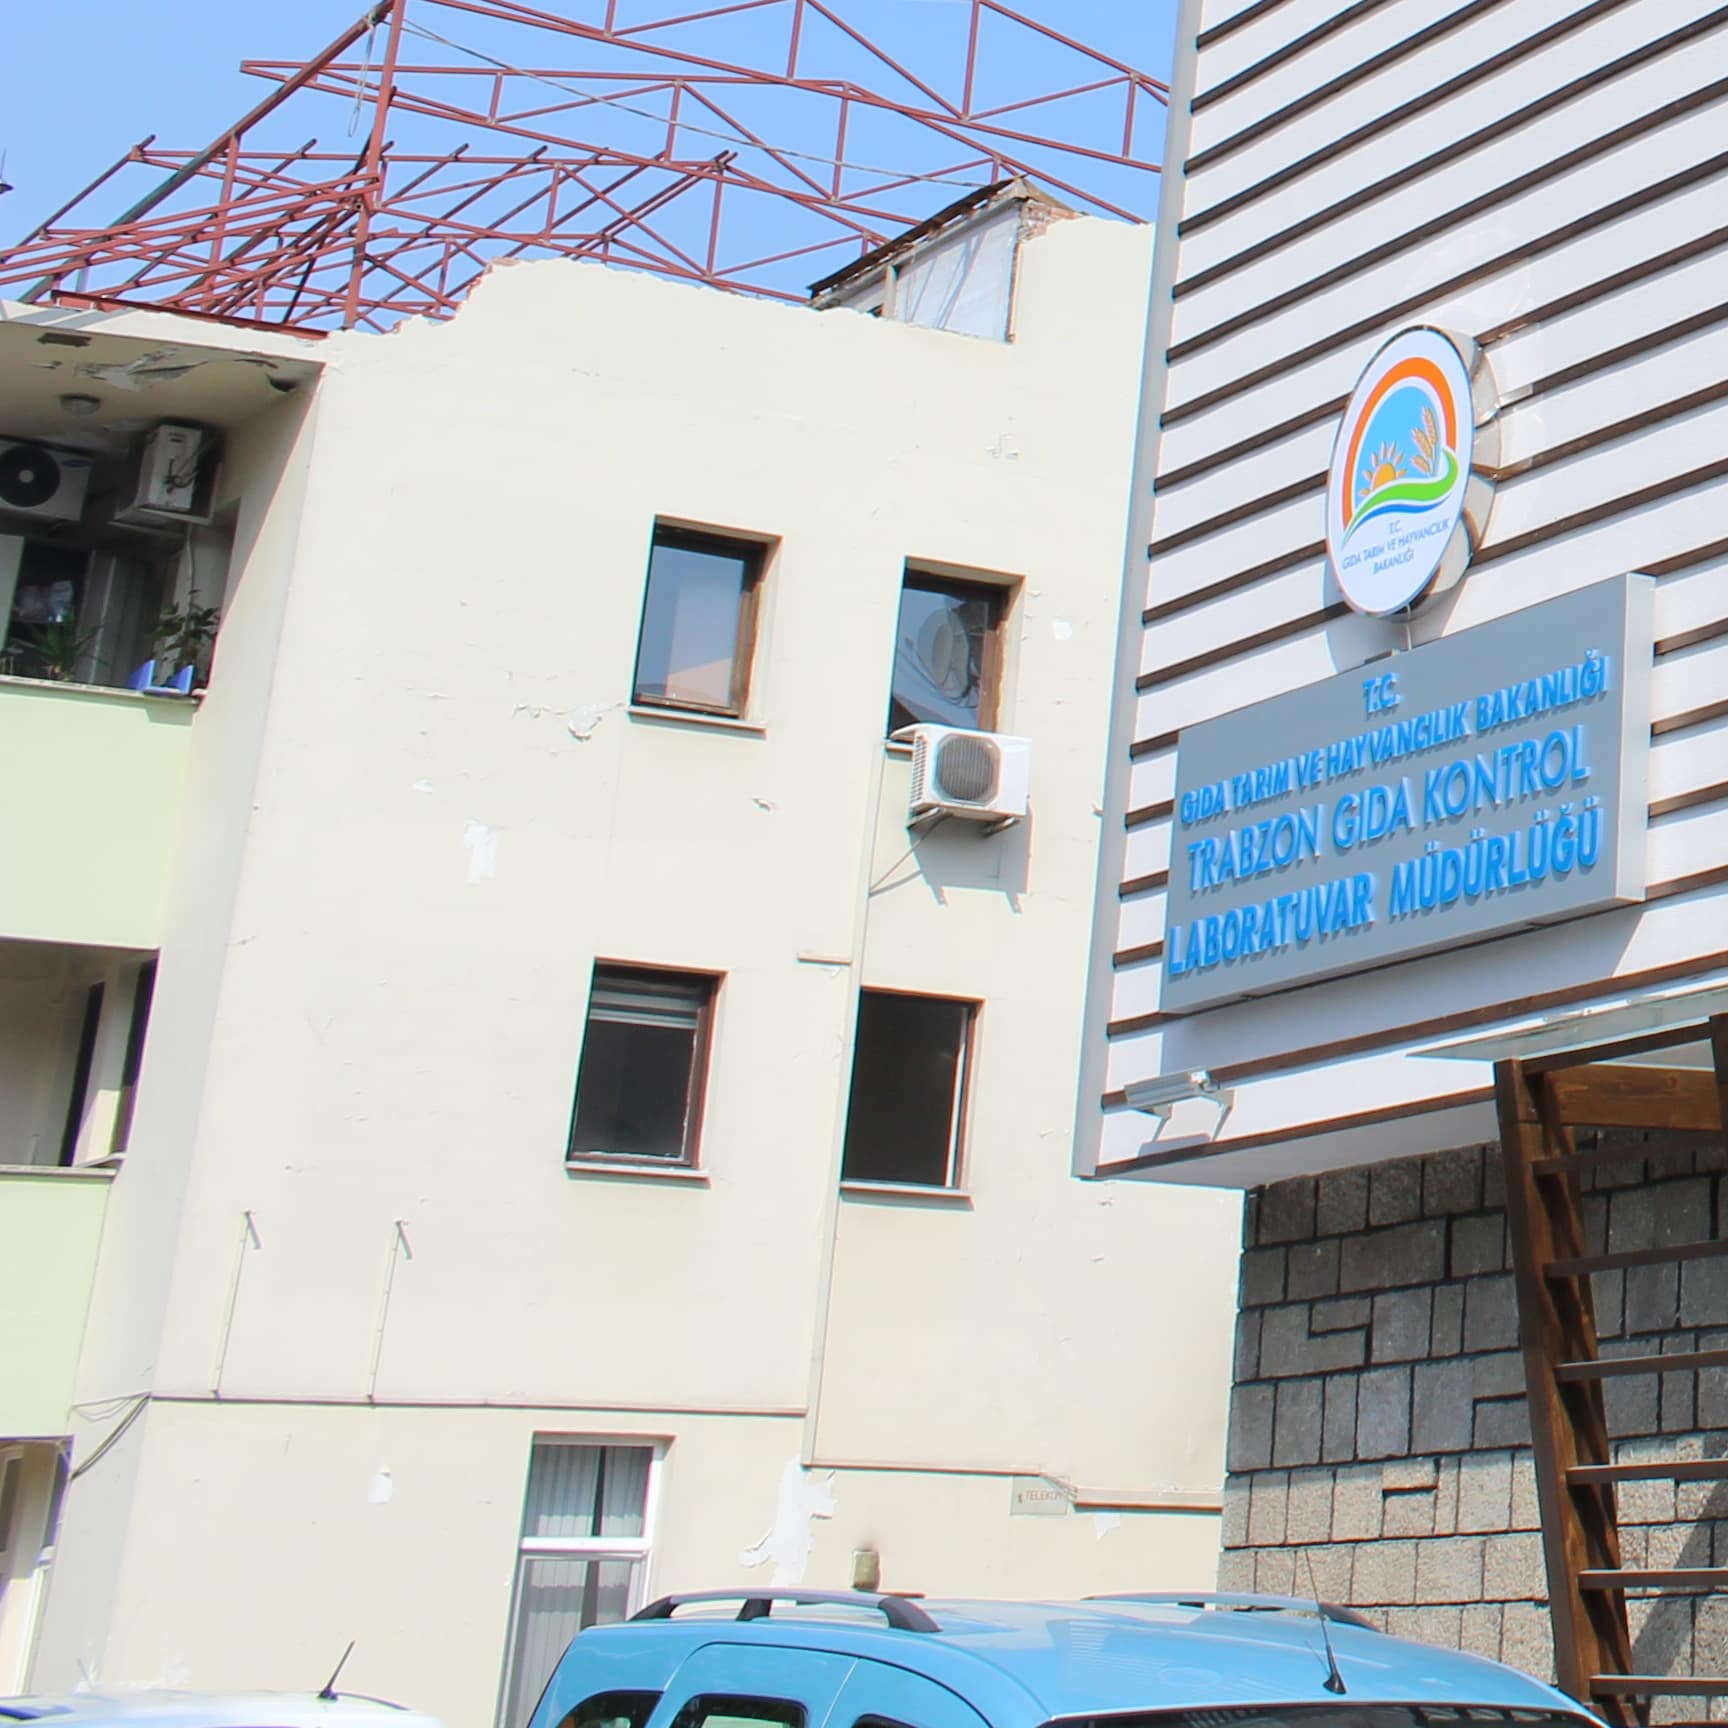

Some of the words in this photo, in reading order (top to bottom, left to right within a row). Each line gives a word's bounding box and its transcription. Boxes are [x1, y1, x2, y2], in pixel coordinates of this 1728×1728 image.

[1181, 780, 1231, 823] GIDA
[1232, 759, 1296, 808] TARIM
[1298, 748, 1325, 787] VE
[1327, 700, 1472, 778] HAYVANCILIK
[1476, 649, 1611, 732] BAKANLIĞI
[1363, 672, 1403, 713] T.C.
[1168, 872, 1377, 974] LABORATUVAR
[1390, 794, 1604, 917] MÜDÜRLÜĞÜ
[1187, 803, 1325, 891] TRABZON
[1333, 776, 1416, 849] GIDA
[1425, 725, 1592, 823] KONTROL
